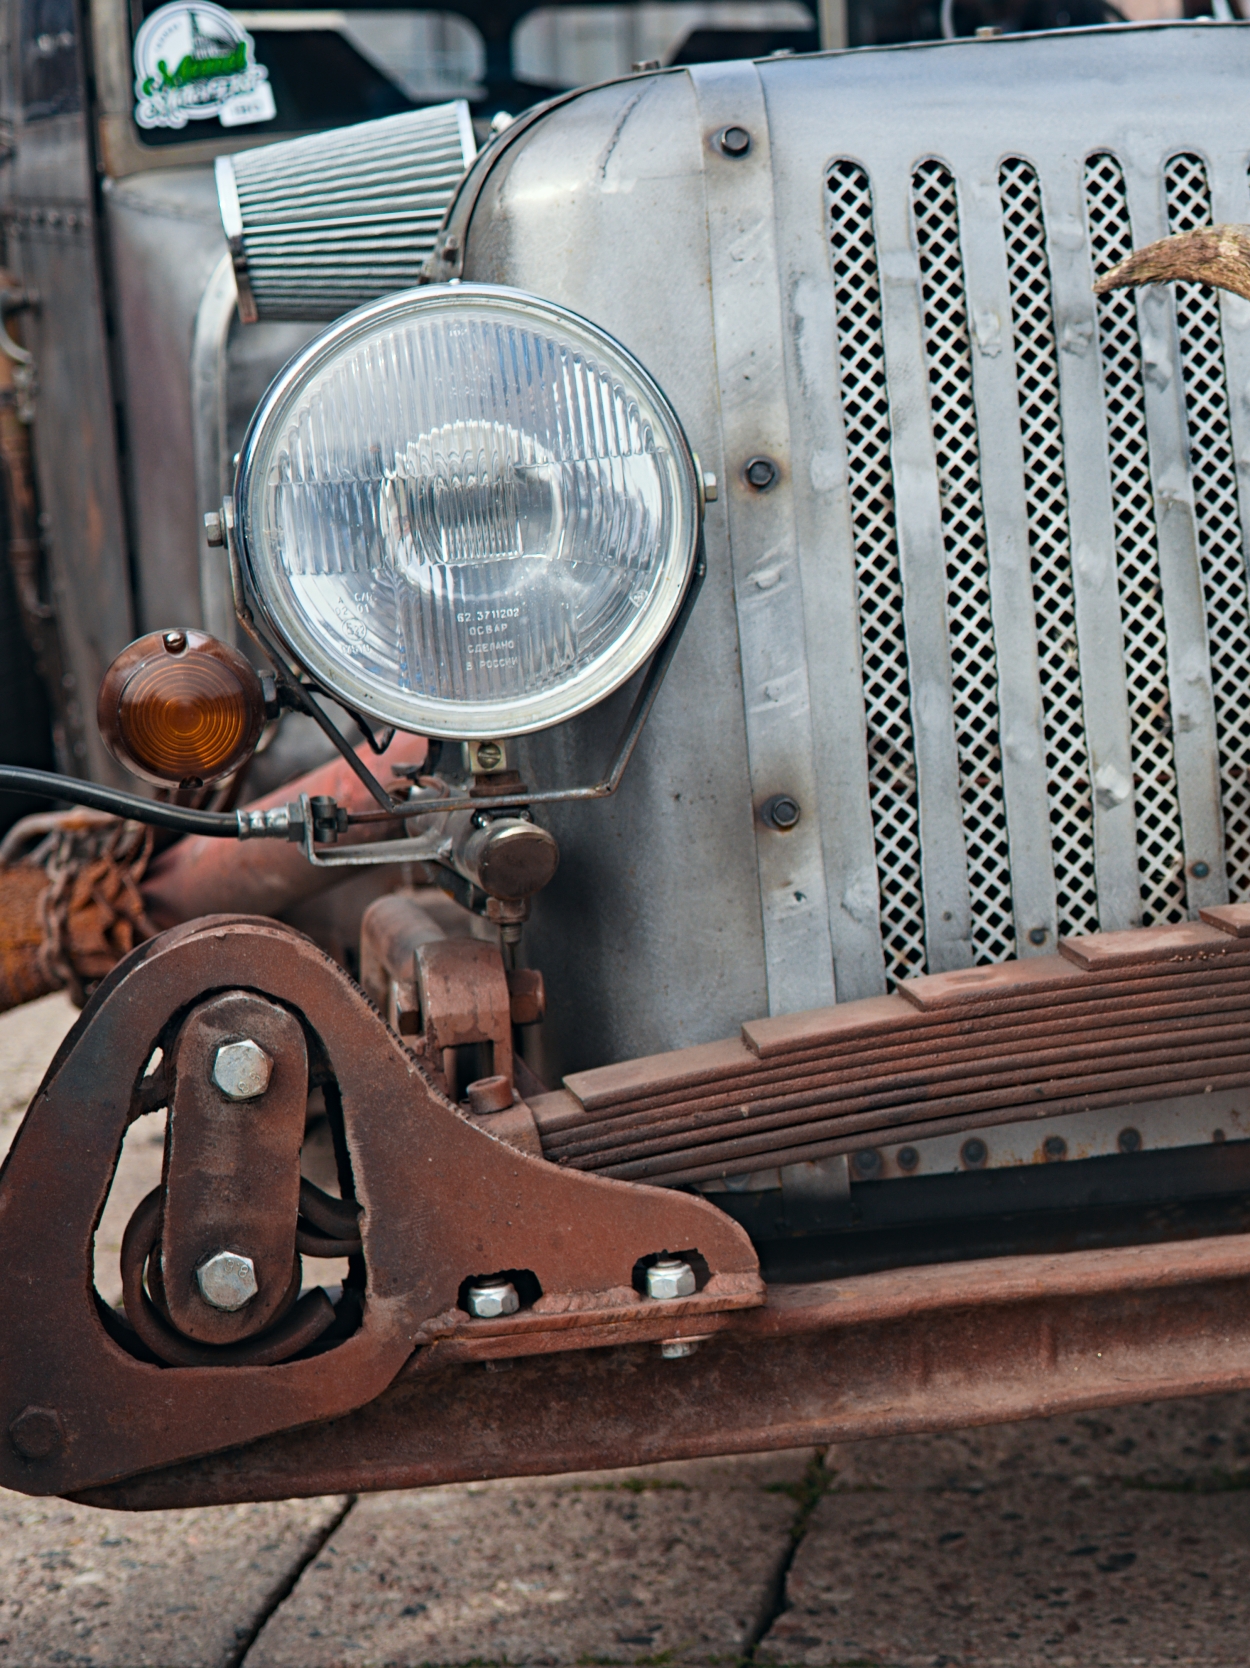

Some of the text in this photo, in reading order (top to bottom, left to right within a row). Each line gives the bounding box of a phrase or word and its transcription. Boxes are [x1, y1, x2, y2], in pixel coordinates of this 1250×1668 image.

[456, 607, 520, 623] 62.3711202
[469, 623, 508, 636] ОСВАР
[467, 640, 515, 654] СДЕЛАНО
[466, 656, 518, 671] В РОССИИ
